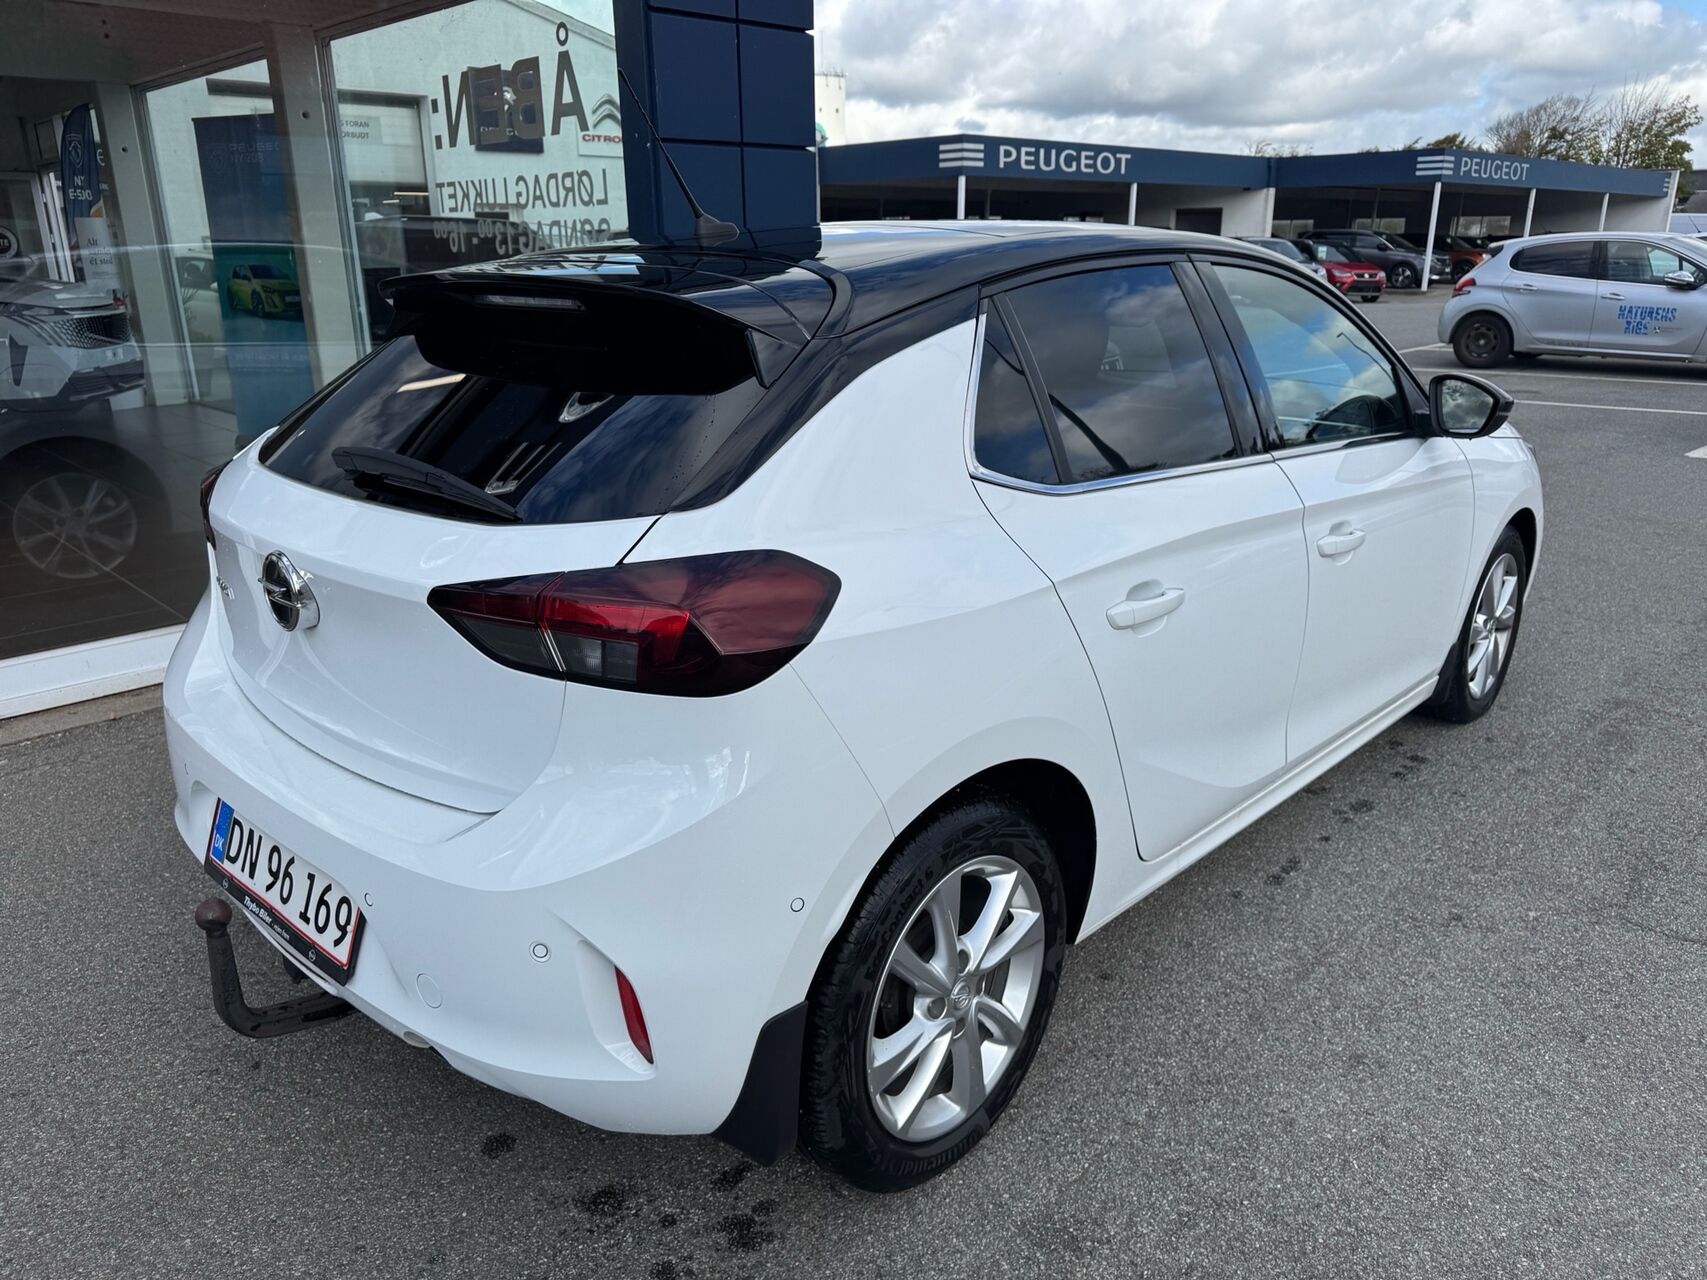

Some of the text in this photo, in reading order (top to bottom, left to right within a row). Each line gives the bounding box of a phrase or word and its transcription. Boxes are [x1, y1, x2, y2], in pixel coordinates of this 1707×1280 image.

[341, 131, 369, 139] ORBUDT
[582, 133, 623, 144] CITRO
[999, 144, 1132, 175] PEUGEOT
[1459, 156, 1530, 181] PEUGEOT
[214, 833, 225, 851] DK
[225, 816, 353, 948] DN 96 169
